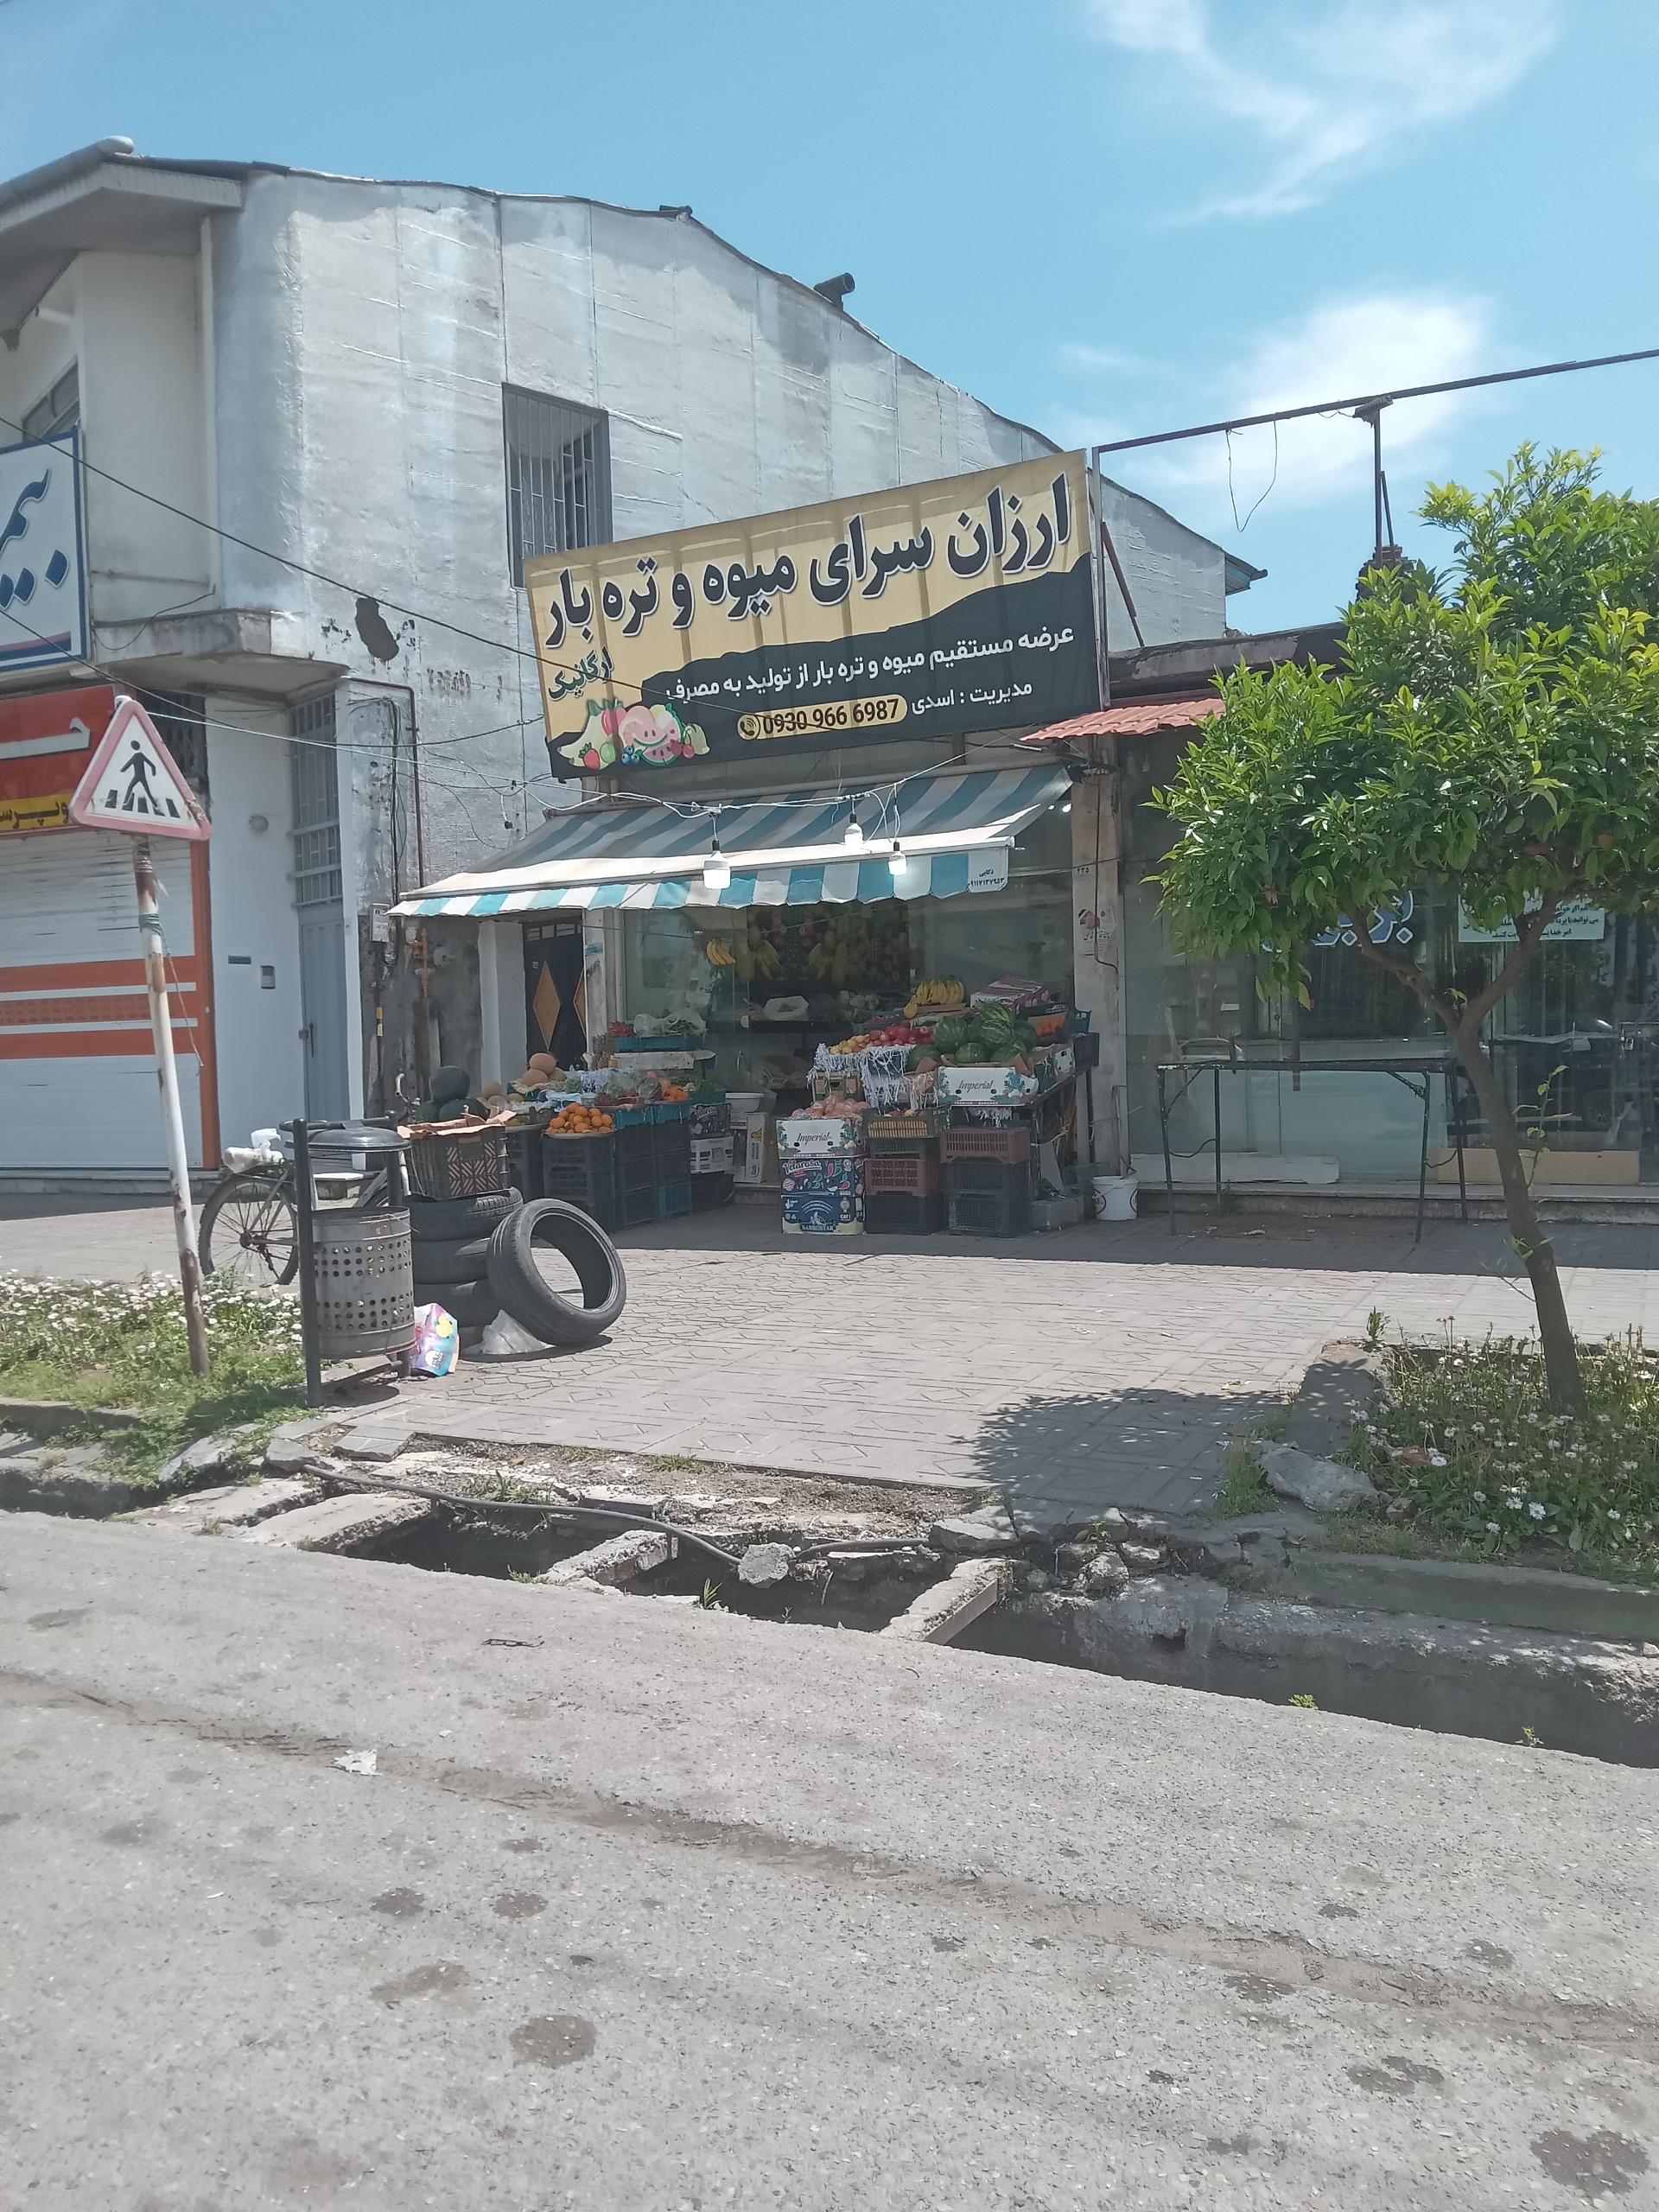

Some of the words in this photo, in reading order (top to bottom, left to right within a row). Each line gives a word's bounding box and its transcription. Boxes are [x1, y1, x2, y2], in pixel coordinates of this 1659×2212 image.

[947, 472, 1070, 578] ارزان
[809, 513, 934, 606] سرای
[602, 556, 659, 636] تره
[671, 571, 695, 629] و
[703, 555, 797, 620] میوه
[545, 568, 593, 648] بار
[1018, 626, 1074, 652] عرضه
[882, 652, 925, 675] میوه
[929, 639, 1014, 670] مستقیم
[548, 645, 614, 701] ارگانیک
[746, 668, 791, 694] تولید
[796, 664, 809, 690] از
[812, 661, 833, 686] بار
[838, 657, 864, 682] تره
[868, 658, 879, 678] و
[665, 678, 720, 704] مصرف
[723, 677, 741, 697] به
[970, 682, 1033, 705] مدیریت
[912, 689, 955, 715] اسدی
[763, 710, 807, 735] 0930
[813, 705, 848, 728] 966
[853, 699, 899, 723] 6987
[13, 800, 69, 829] وپر
[958, 1080, 995, 1093] Imperial
[797, 1132, 830, 1145] Imperial
